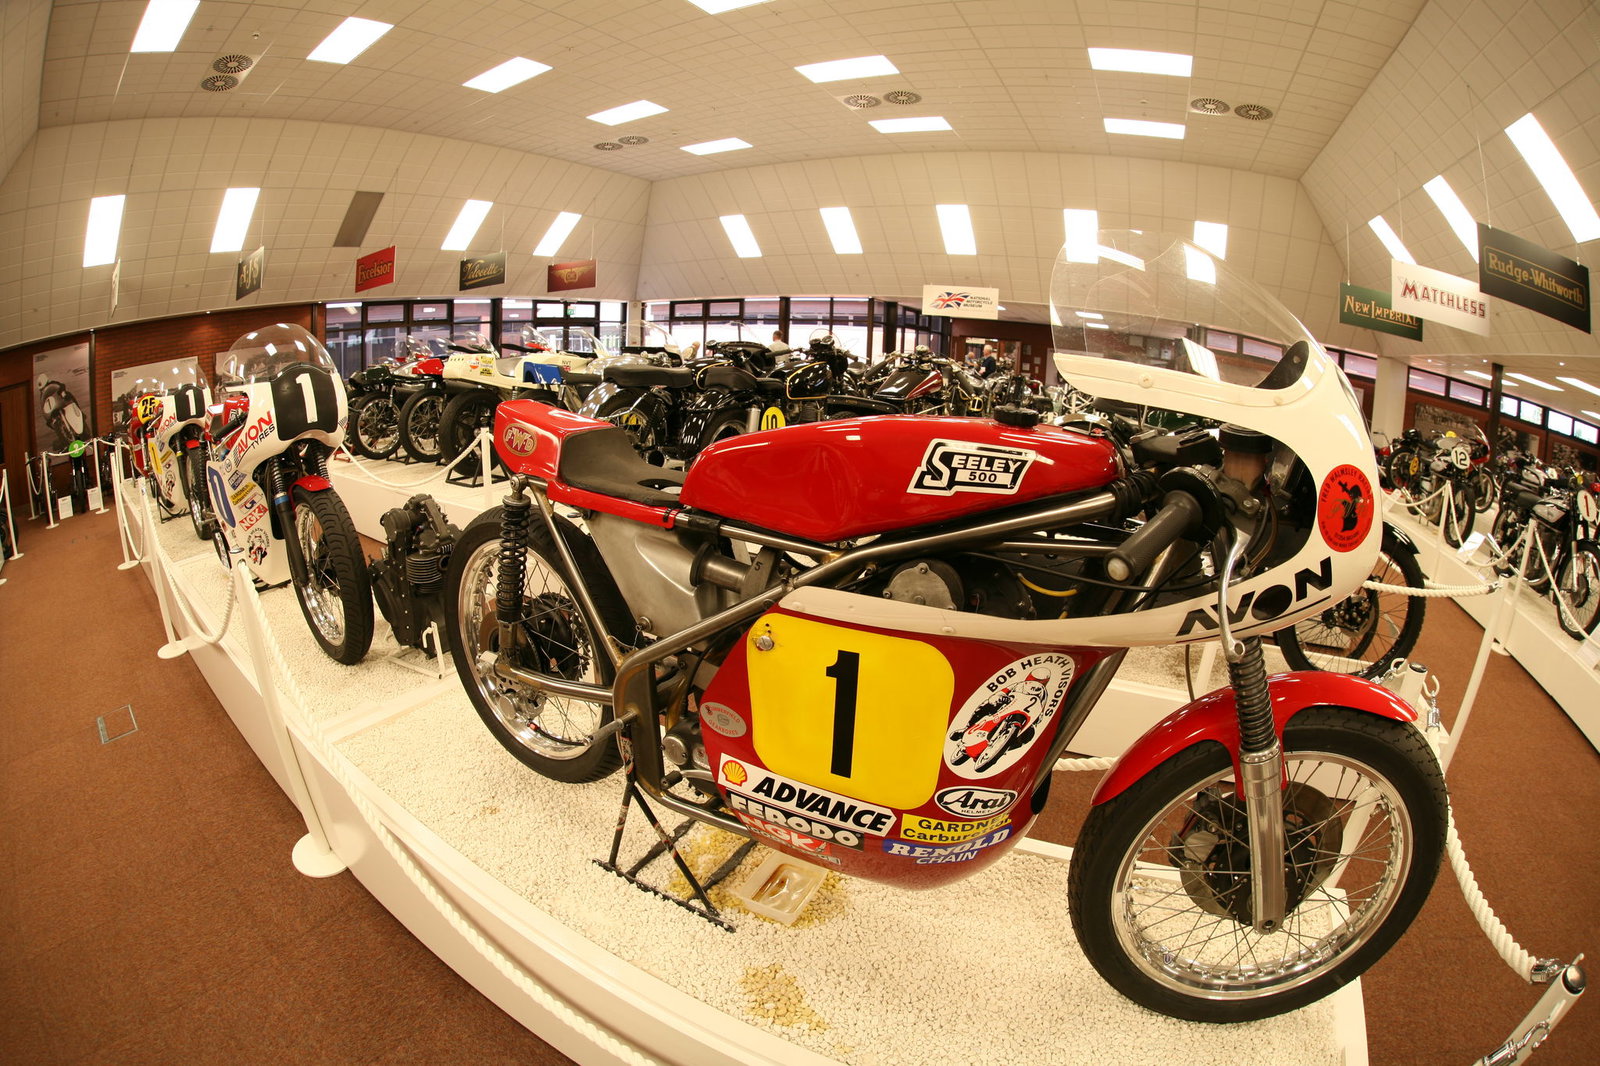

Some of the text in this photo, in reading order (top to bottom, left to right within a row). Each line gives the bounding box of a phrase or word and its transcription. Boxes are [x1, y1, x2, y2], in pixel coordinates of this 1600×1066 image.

[358, 260, 393, 285] Excelsior
[462, 259, 503, 281] Velocette
[1488, 252, 1583, 305] Rudge-Whitworth
[1343, 295, 1370, 315] NEW
[1401, 281, 1486, 319] MATCHLESS
[186, 389, 197, 416] 1
[295, 373, 318, 424] 1
[238, 411, 273, 458] AVON
[252, 423, 276, 449] TYRES
[922, 445, 1022, 488] SEELEY
[1454, 450, 1468, 467] 12
[968, 471, 997, 483] 500
[213, 474, 228, 520] 1
[1583, 494, 1590, 518] 1
[240, 507, 265, 530] NGK
[754, 561, 763, 571] 5
[1175, 556, 1333, 637] AVON
[986, 655, 1072, 717] BOB HEATH VISORS
[826, 650, 860, 779] 1
[1023, 697, 1038, 713] 2
[752, 776, 892, 833] ADVANCE
[942, 790, 1010, 810] Arai
[730, 794, 860, 847] FERODO
[738, 812, 816, 852] NGK
[888, 828, 1011, 858] RENOLD
[916, 850, 978, 865] CHAIN
